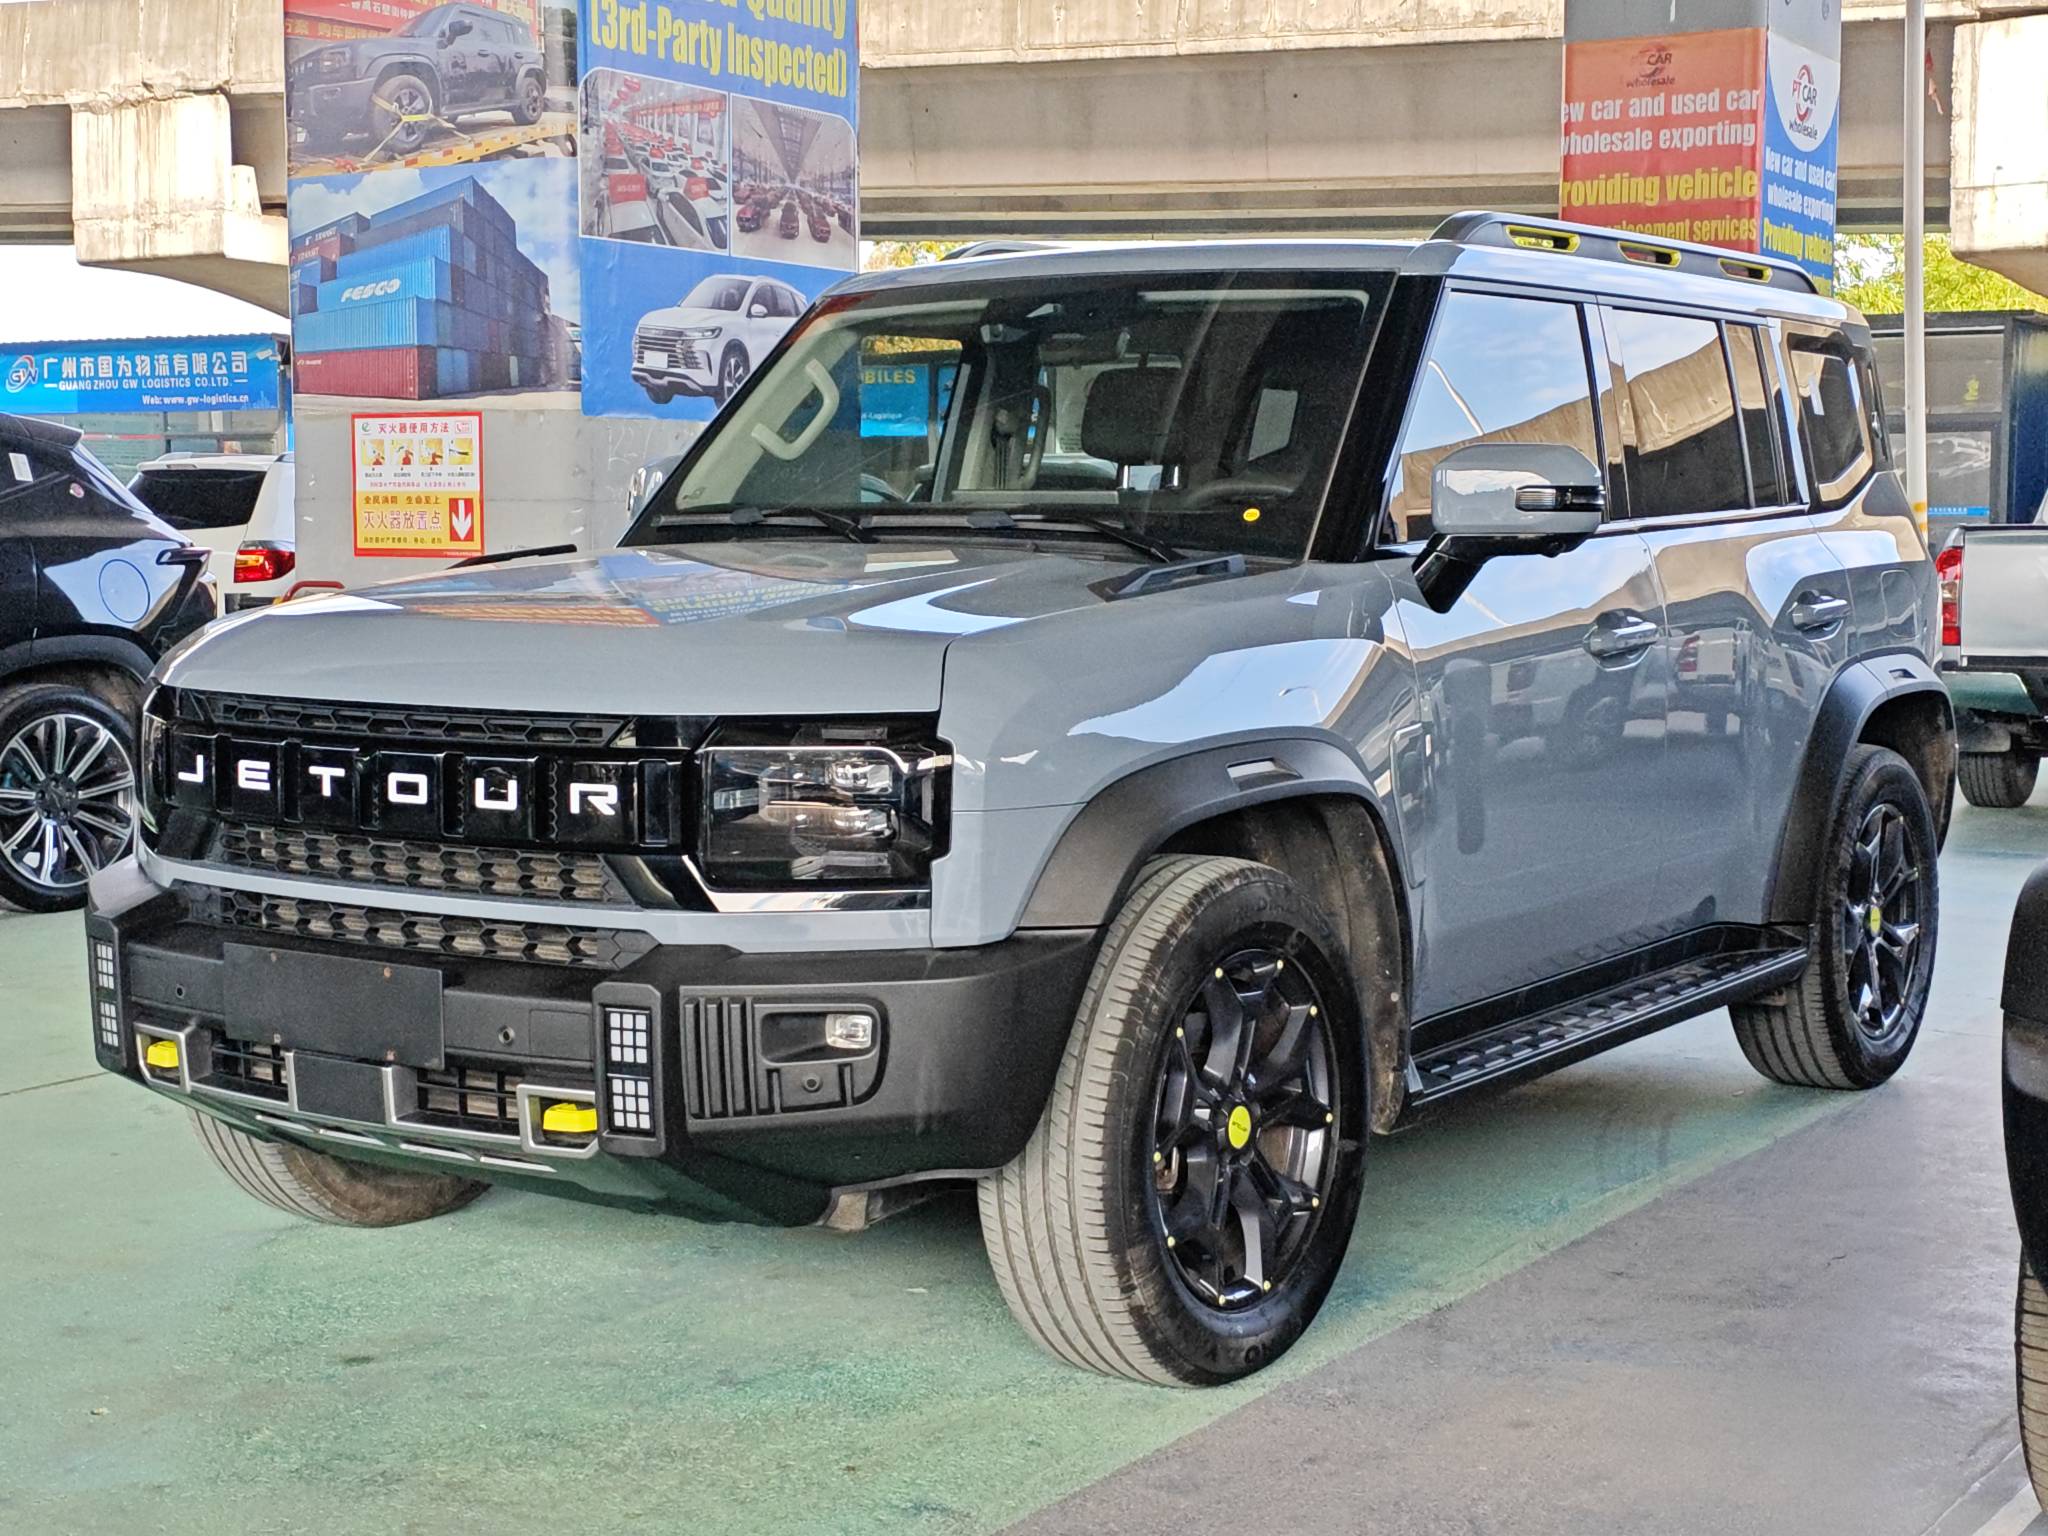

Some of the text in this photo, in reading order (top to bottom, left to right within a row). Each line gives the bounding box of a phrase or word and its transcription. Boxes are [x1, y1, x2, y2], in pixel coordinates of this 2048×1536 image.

[728, 22, 847, 97] Inspected)
[1591, 98, 1623, 121] car
[1628, 93, 1665, 118] and
[1671, 88, 1720, 115] used
[1726, 89, 1760, 111] car
[1802, 84, 1817, 105] CAR
[1659, 120, 1756, 151] exporting
[1765, 146, 1781, 174] New
[1782, 154, 1794, 177] car
[1794, 160, 1807, 182] and
[1666, 165, 1758, 201] vehicle
[1693, 215, 1757, 242] services
[93, 379, 119, 390] ZHOU
[122, 379, 138, 389] GW
[142, 377, 190, 389] LOGISTICS
[378, 422, 450, 434] 灭火器使用方法
[364, 511, 442, 530] 灭火器放置点
[177, 753, 618, 816] JETOUR
